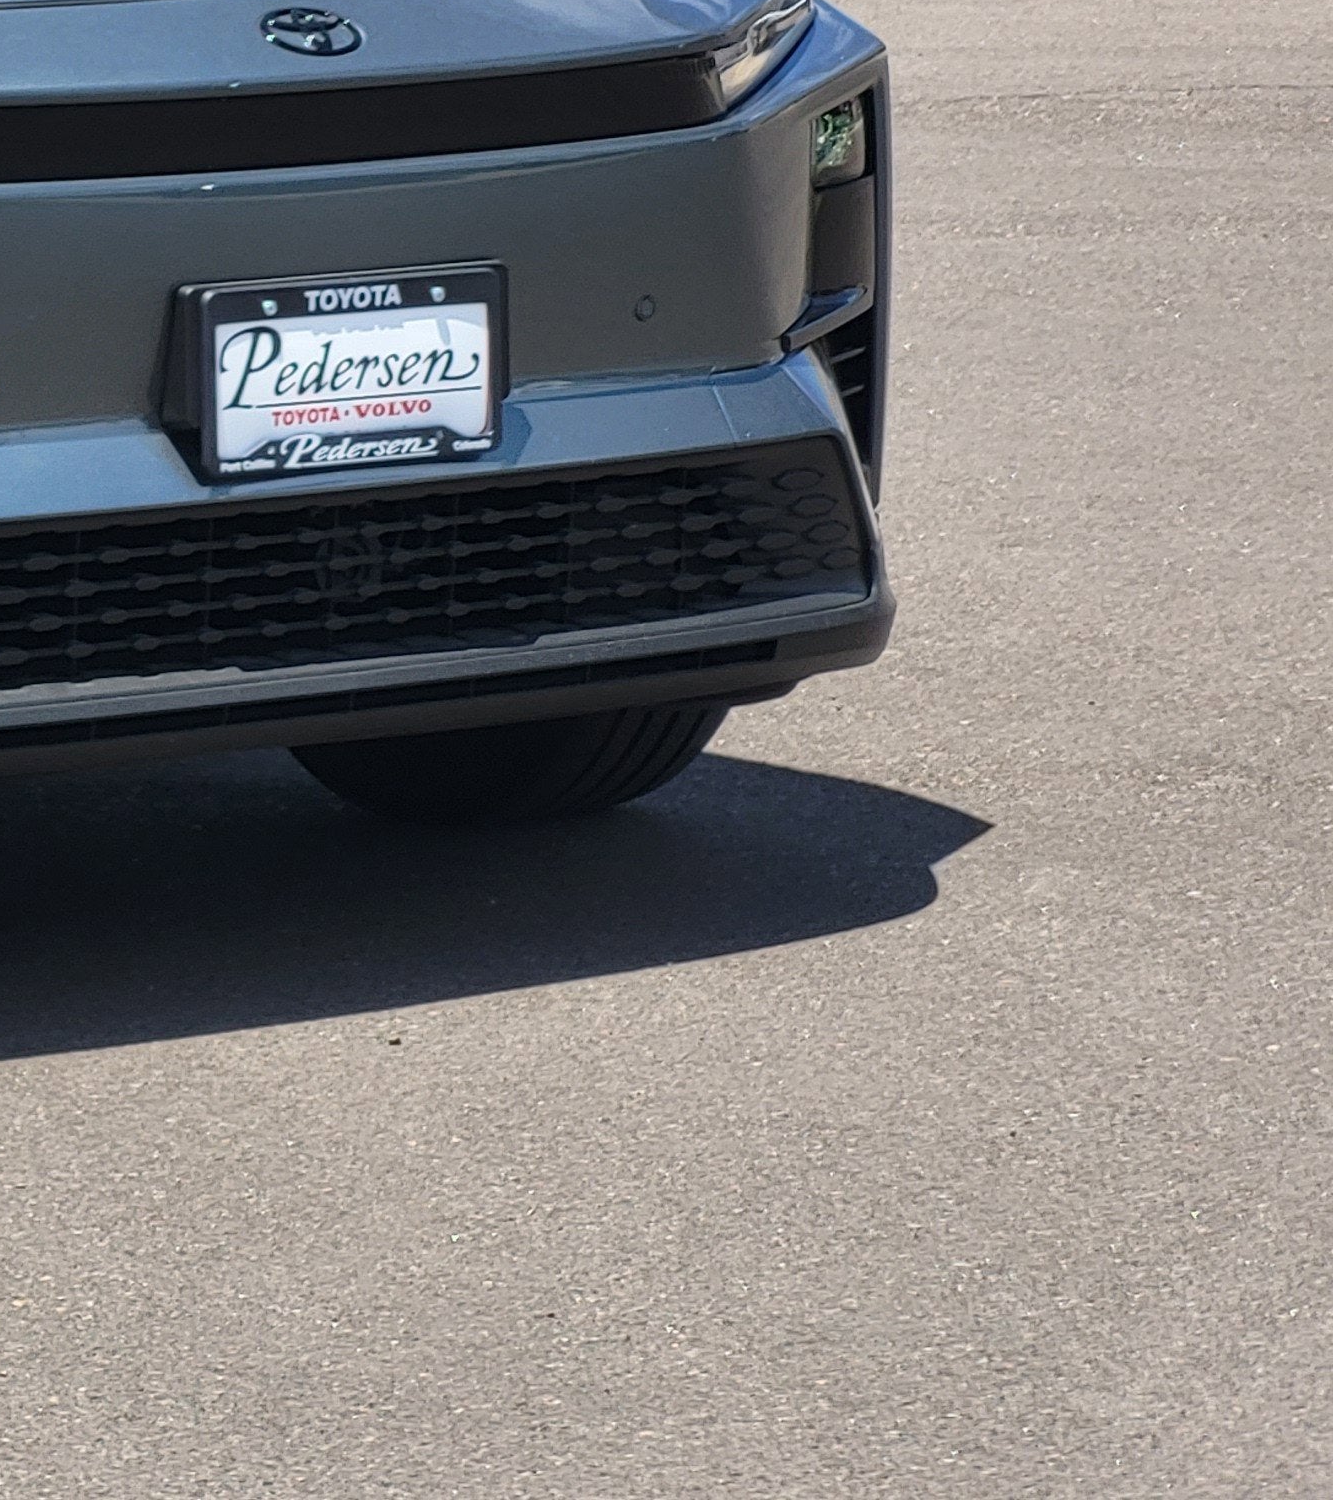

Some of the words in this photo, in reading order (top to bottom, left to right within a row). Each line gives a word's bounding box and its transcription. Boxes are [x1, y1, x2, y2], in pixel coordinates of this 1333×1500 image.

[303, 284, 402, 312] TOYOTA
[219, 325, 480, 411] Pedersen
[271, 406, 341, 427] TOYOTA
[354, 399, 433, 419] VOLVO
[279, 433, 438, 468] Pedersen
